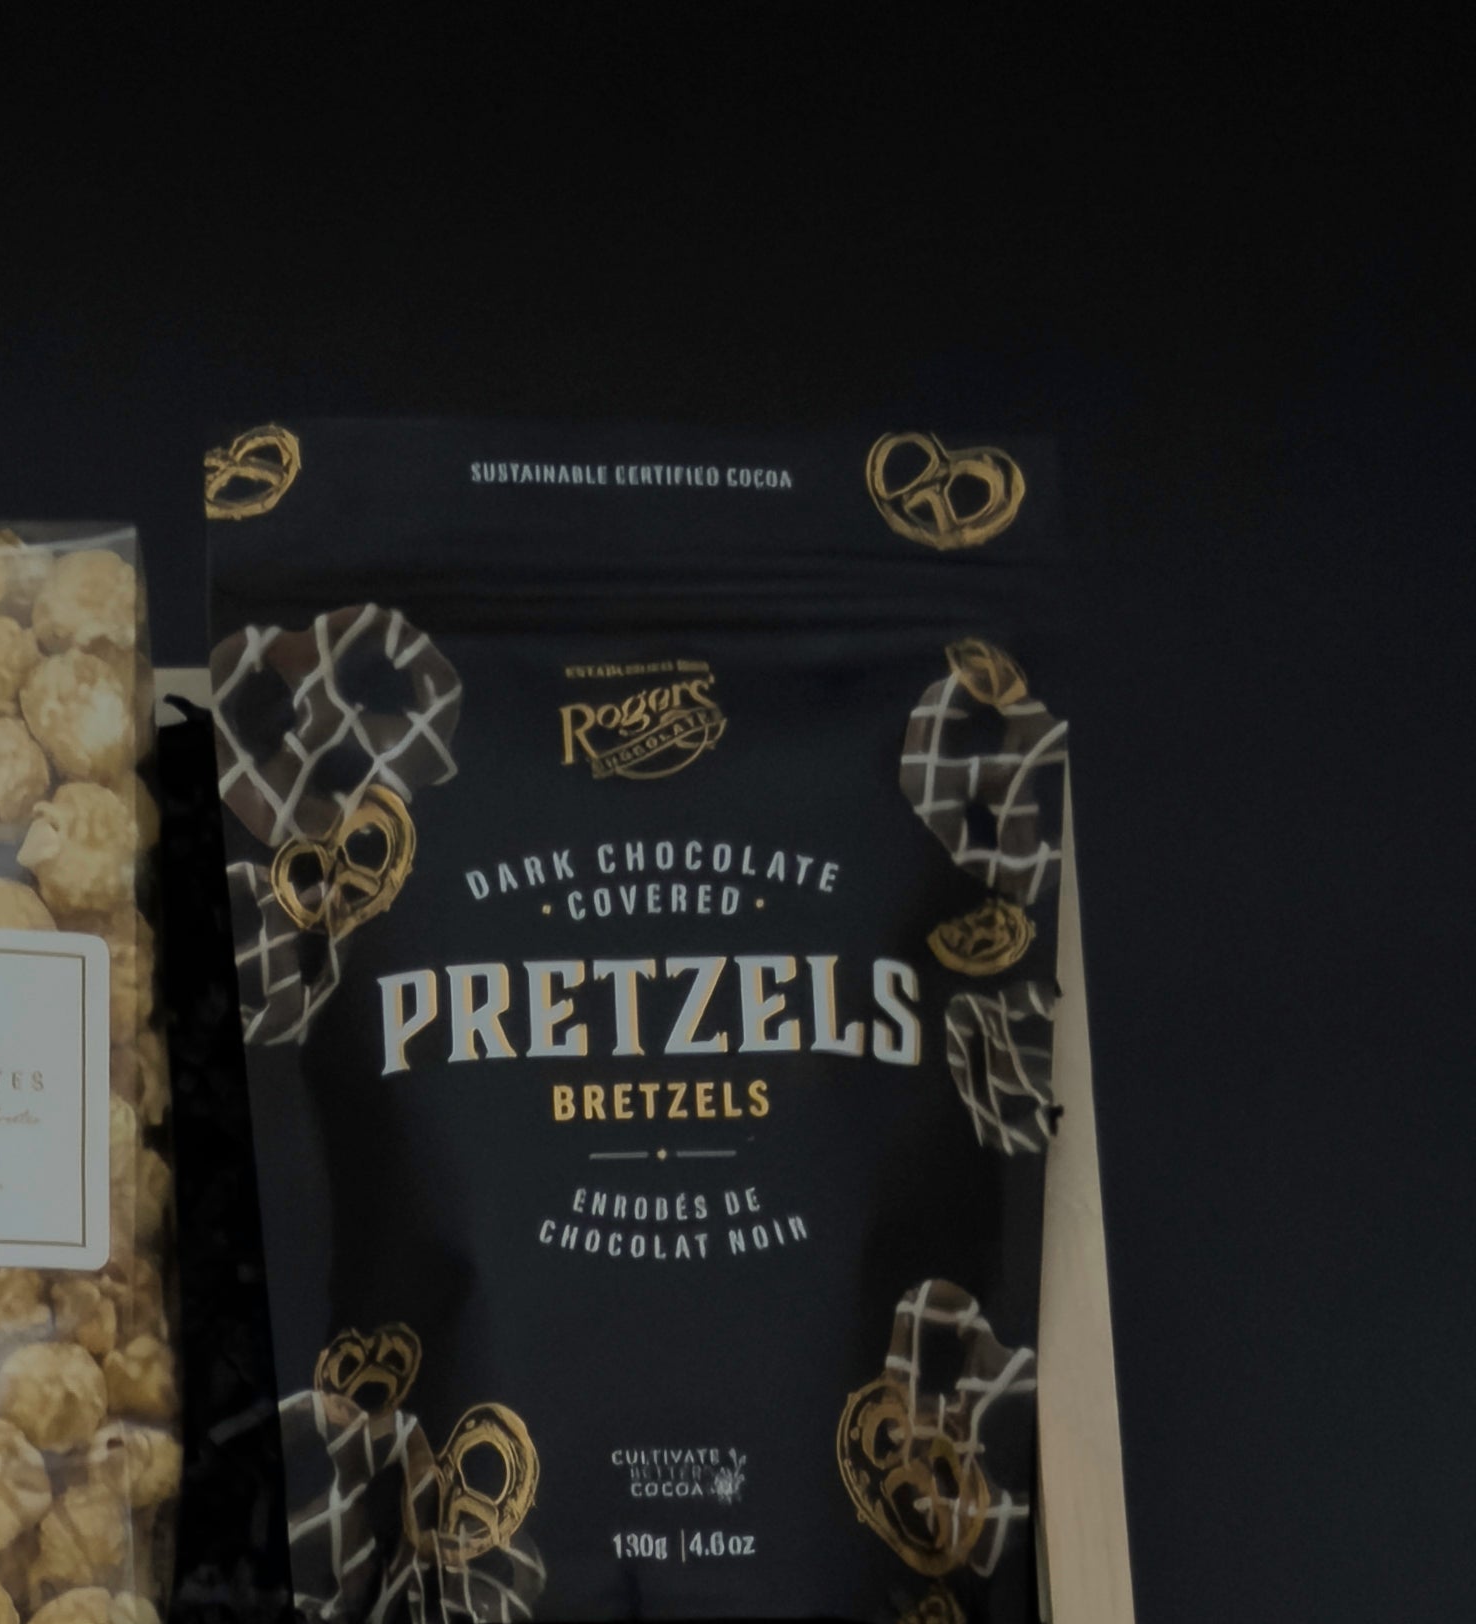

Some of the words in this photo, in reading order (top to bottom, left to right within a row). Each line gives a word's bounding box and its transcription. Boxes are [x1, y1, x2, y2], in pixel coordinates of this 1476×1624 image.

[469, 461, 606, 486] SUSTAINABLE
[725, 467, 792, 490] COCOA
[465, 850, 574, 901] DARK
[597, 841, 840, 895] CHOCOLATE
[568, 882, 740, 922] COVERED
[377, 955, 922, 1077] PRETZELS
[552, 1079, 771, 1122] BRETZELS
[571, 1187, 709, 1222] ENROBÉS
[724, 1187, 761, 1215] DE
[538, 1219, 710, 1260] CHOCOLAT
[730, 1213, 810, 1257] NOIR
[611, 1448, 720, 1466] CULTIVATE
[630, 1482, 704, 1497] COCOA
